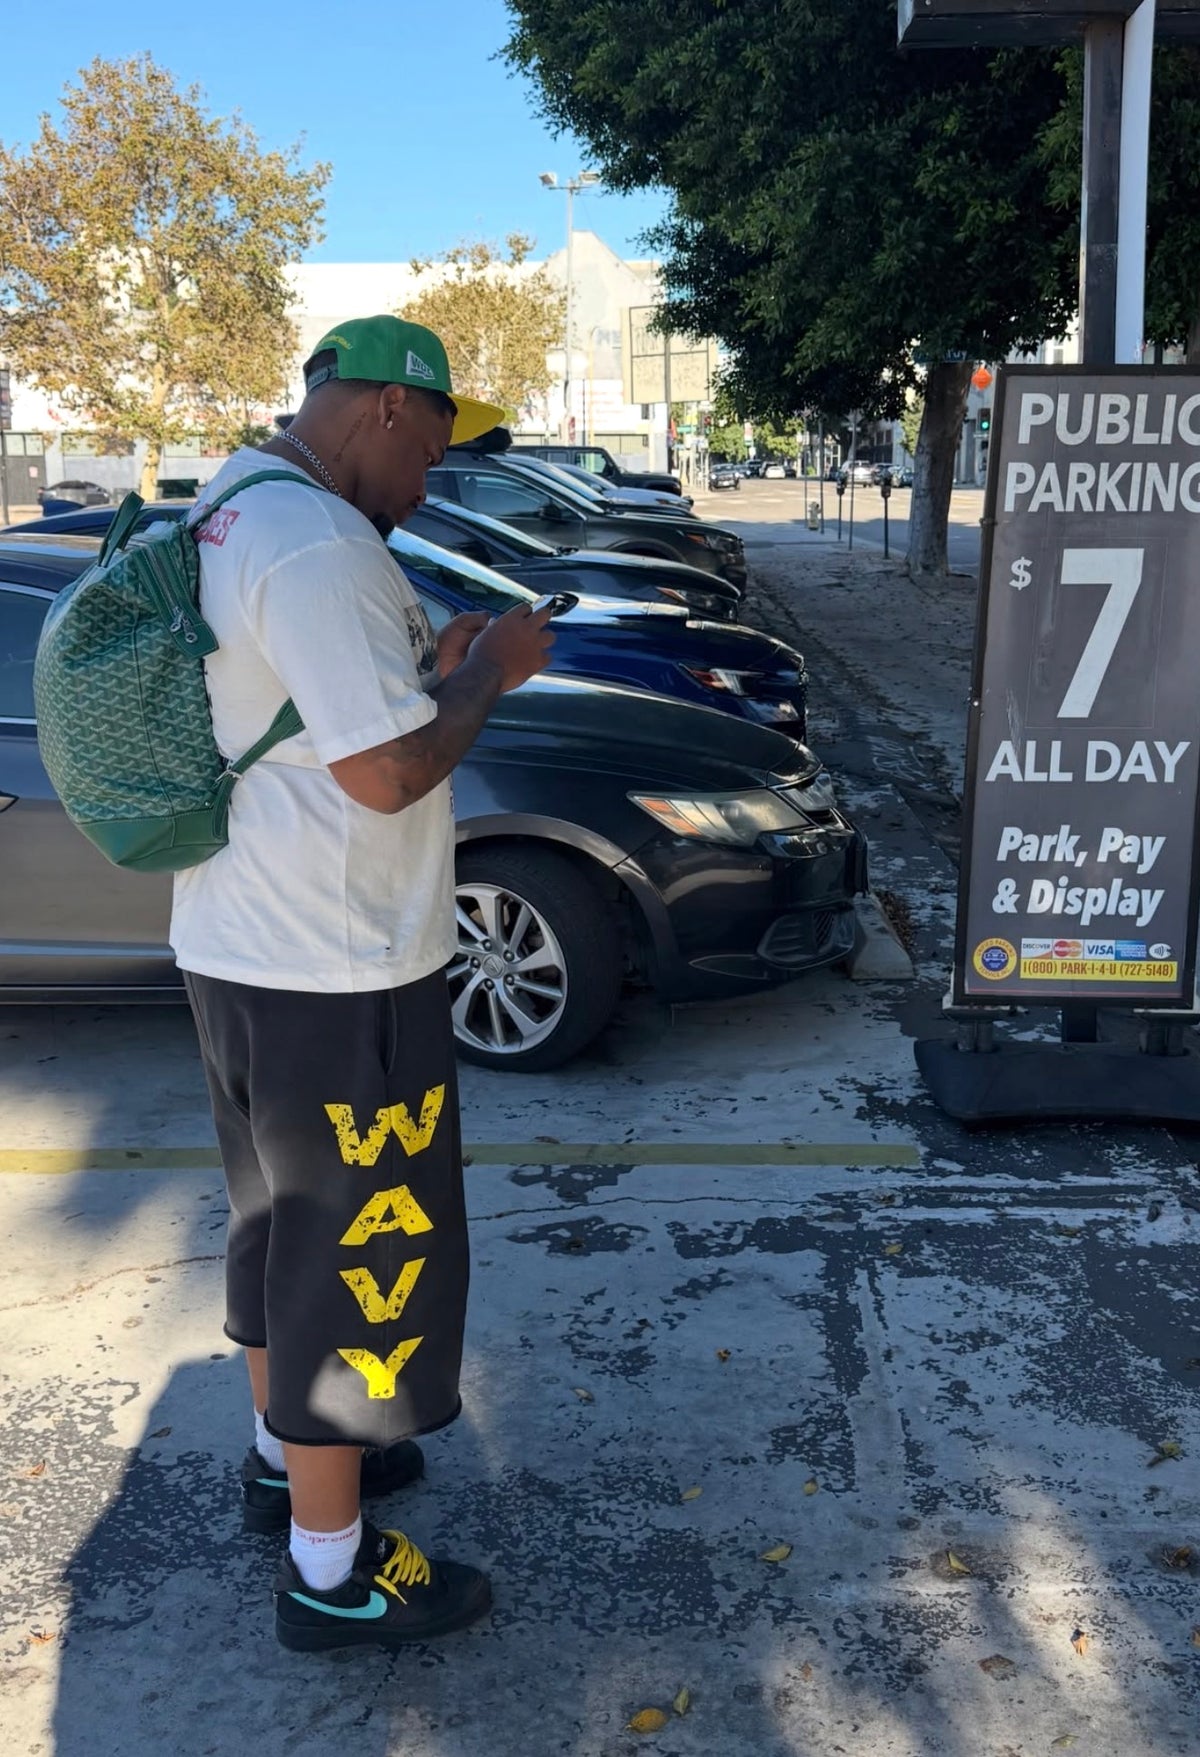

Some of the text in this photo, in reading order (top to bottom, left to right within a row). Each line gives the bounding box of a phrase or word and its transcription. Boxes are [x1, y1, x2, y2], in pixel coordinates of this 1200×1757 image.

[1009, 547, 1145, 719] $ 7
[984, 740, 1191, 783] ALL DAY
[996, 824, 1167, 875] Park, Pay
[992, 875, 1166, 927] & Display
[1087, 944, 1114, 955] VISA
[1119, 963, 1174, 977] (727-5148)
